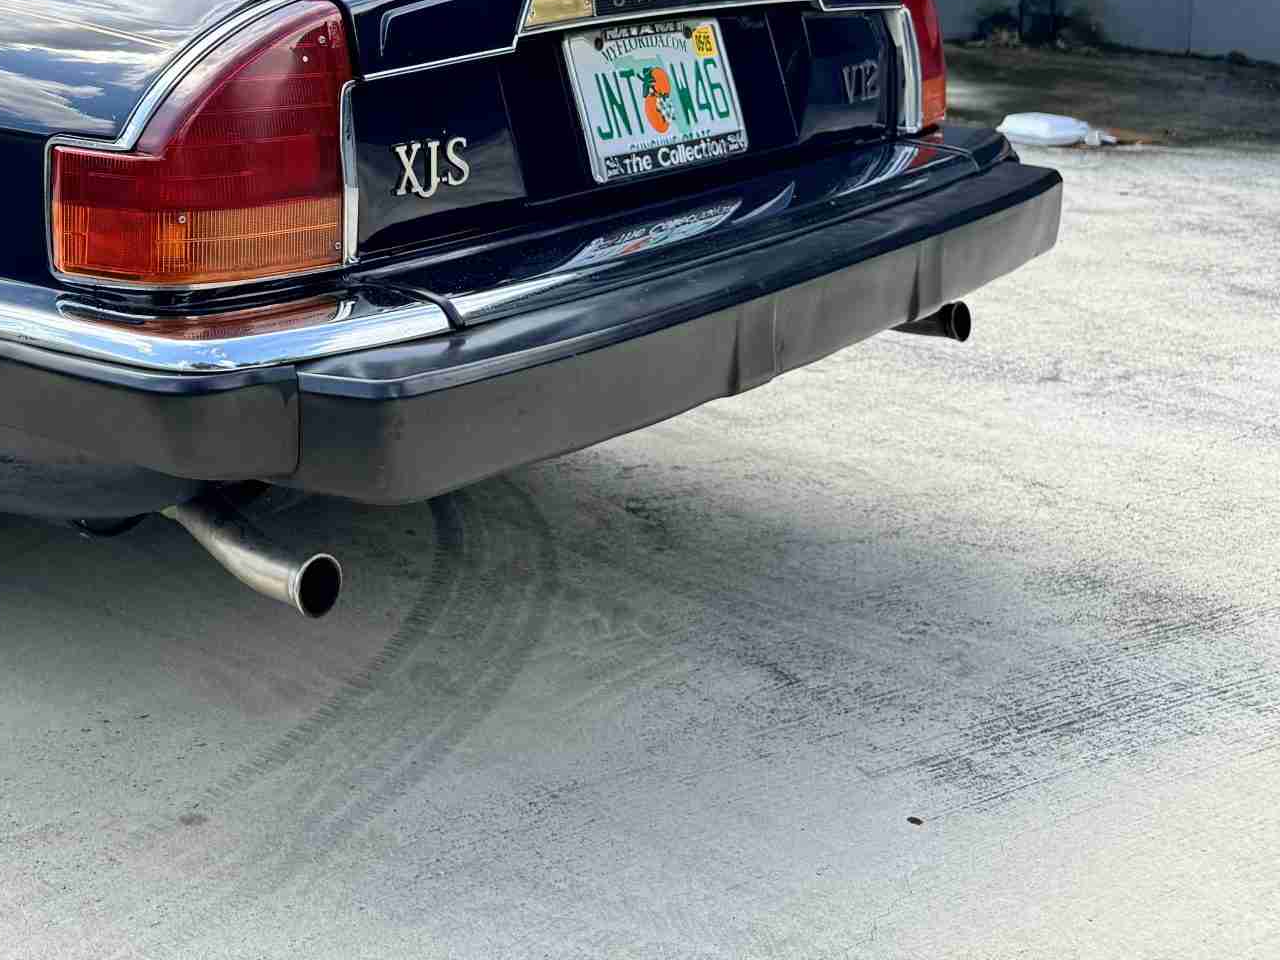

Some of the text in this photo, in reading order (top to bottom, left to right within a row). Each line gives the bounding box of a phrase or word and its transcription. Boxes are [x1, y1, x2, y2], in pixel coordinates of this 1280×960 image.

[594, 57, 730, 141] JNT W46
[842, 59, 881, 105] V12
[394, 136, 470, 198] XJS
[624, 153, 653, 175] the
[657, 138, 730, 168] Collection
